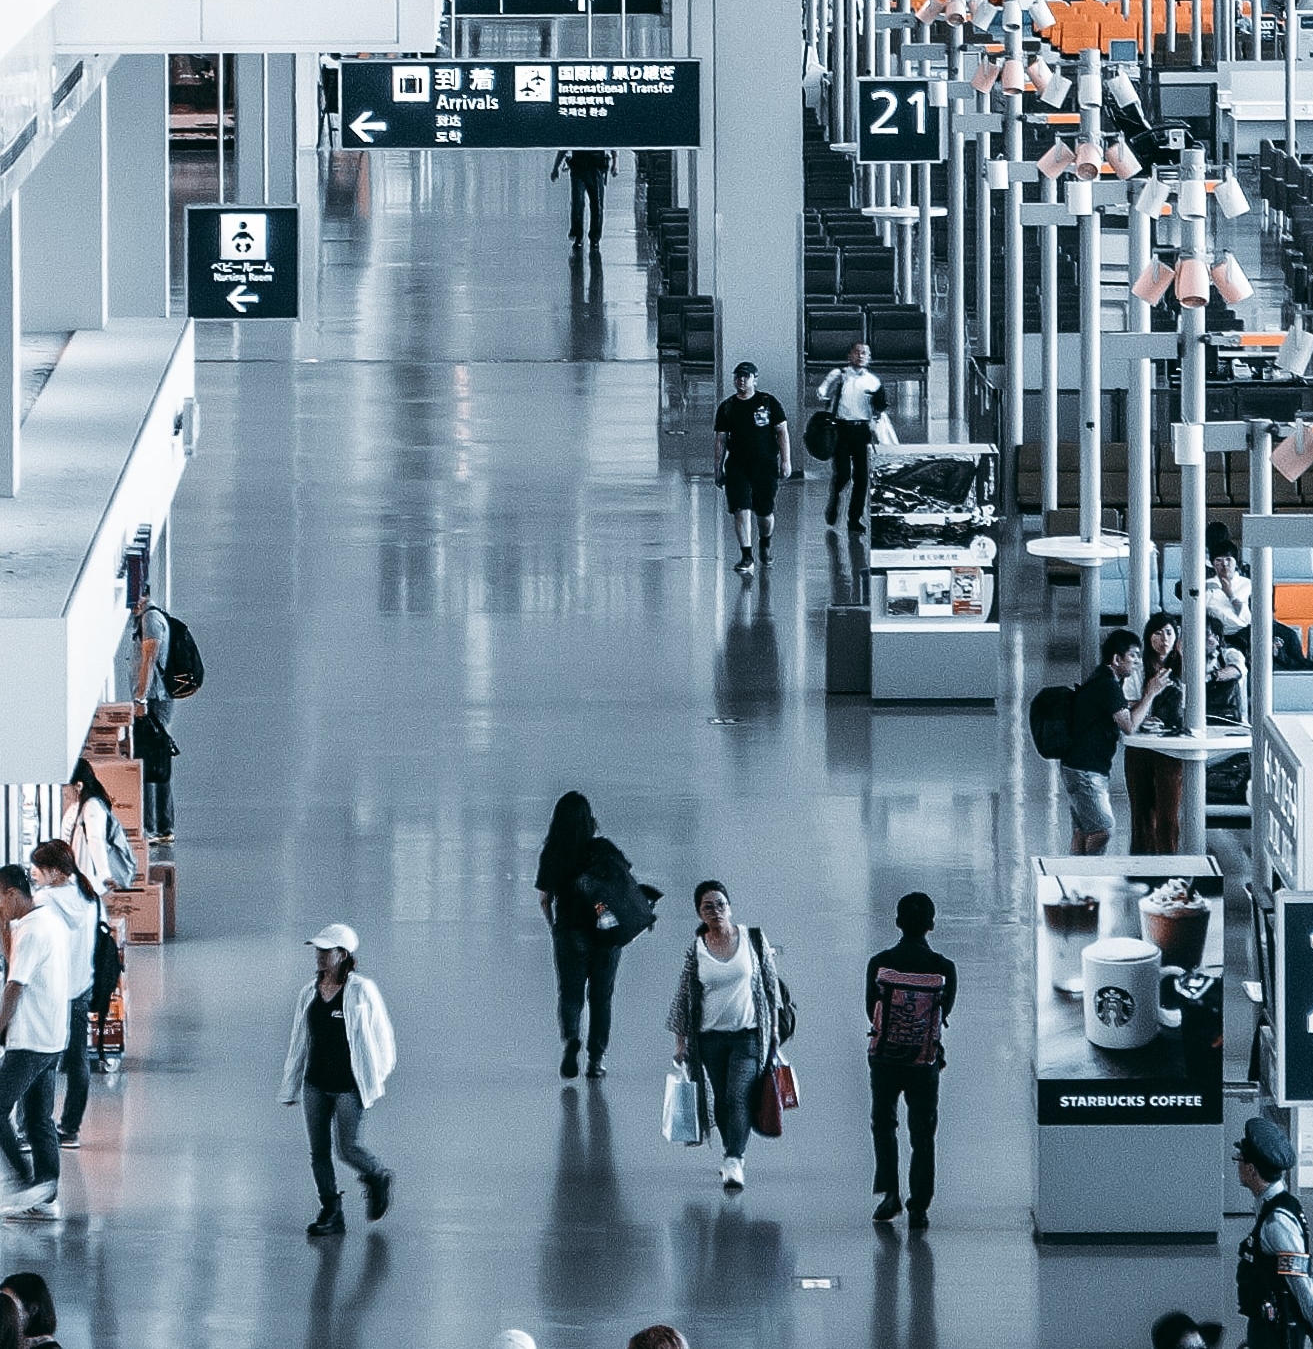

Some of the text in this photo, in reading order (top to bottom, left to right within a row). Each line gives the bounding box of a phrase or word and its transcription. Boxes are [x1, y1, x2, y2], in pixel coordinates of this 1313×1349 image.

[558, 82, 675, 94] International Transfer
[436, 94, 499, 111] Arrivals
[870, 91, 926, 134] 21
[1059, 1095, 1203, 1108] STARBUCKS COFFEE
